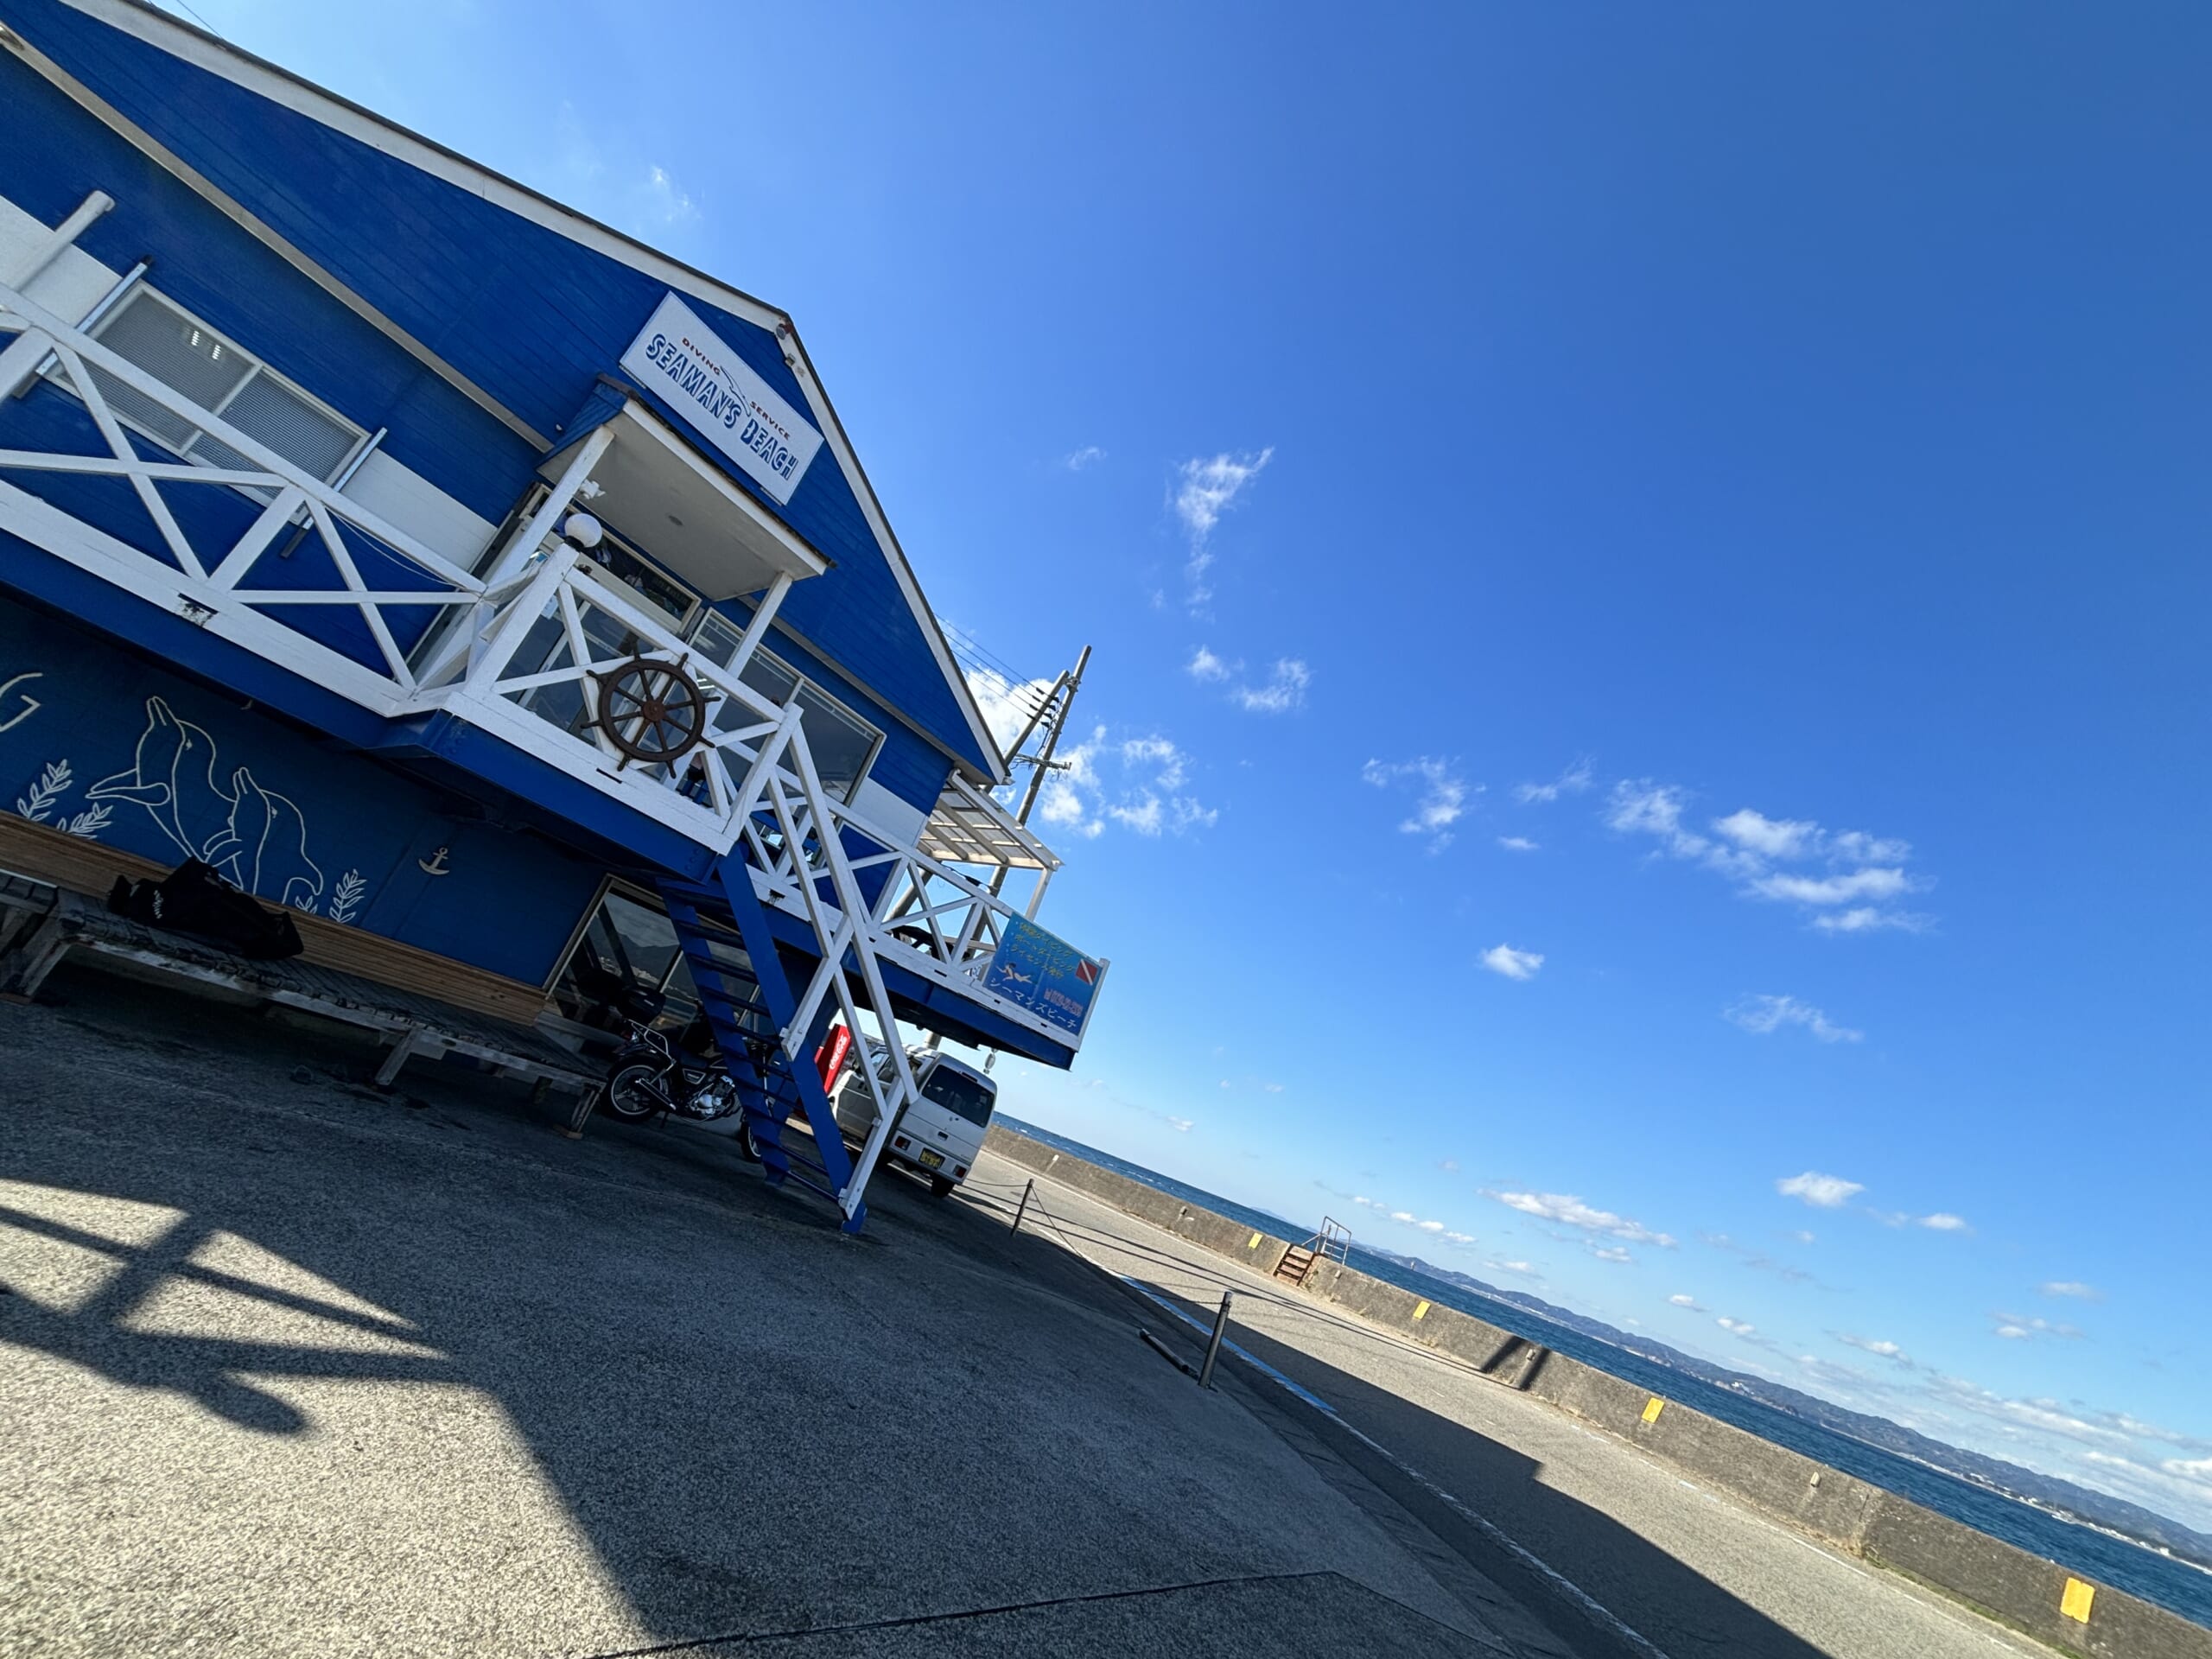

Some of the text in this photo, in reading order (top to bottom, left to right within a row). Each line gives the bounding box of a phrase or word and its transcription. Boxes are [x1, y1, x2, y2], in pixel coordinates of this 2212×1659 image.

[645, 334, 799, 481] SEAMAN'S BEACH
[682, 337, 791, 441] DIVING SERVICE
[989, 978, 1077, 1028] シーマンズビーチ
